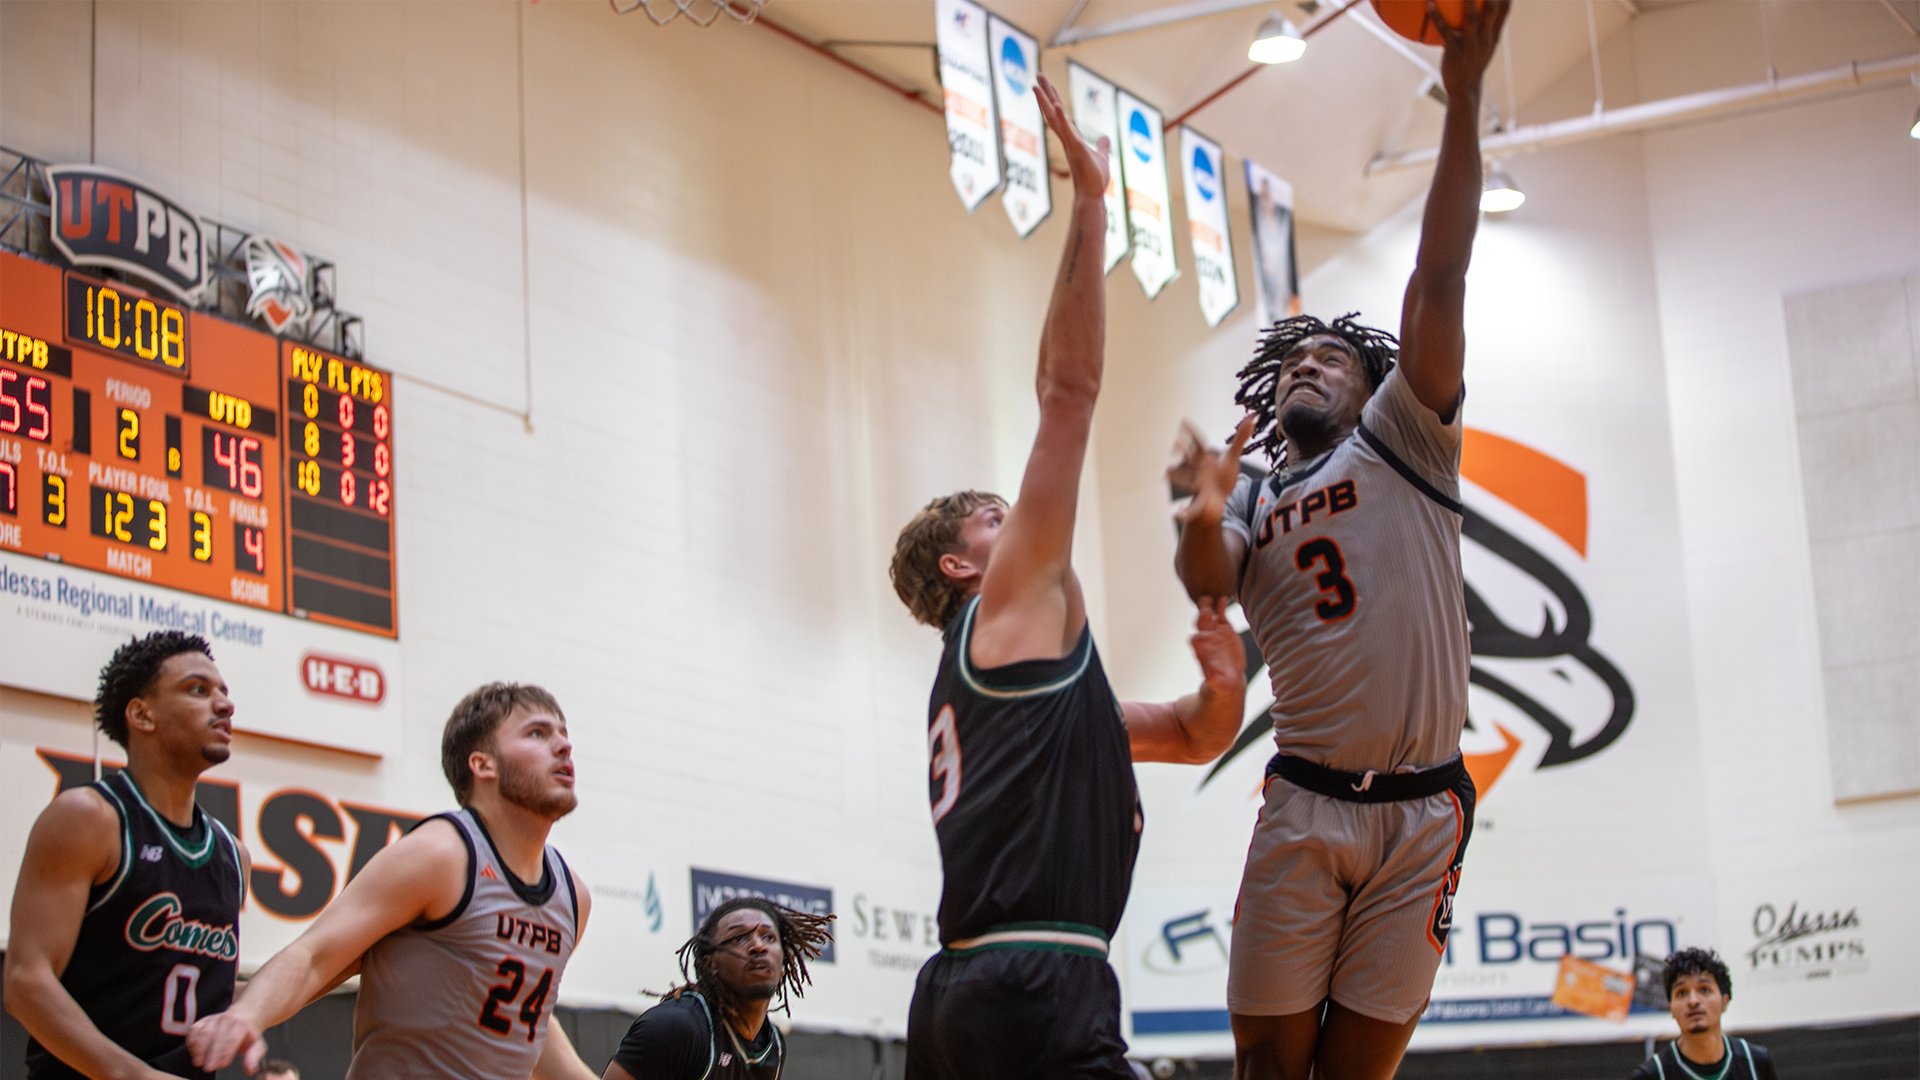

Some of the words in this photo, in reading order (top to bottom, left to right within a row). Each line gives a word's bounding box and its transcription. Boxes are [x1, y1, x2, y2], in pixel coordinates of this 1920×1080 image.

[59, 178, 199, 282] UTPB
[0, 329, 48, 369] TPB
[87, 286, 184, 368] 10:08
[106, 377, 151, 409] PERIOD
[293, 347, 322, 384] PLY
[328, 358, 350, 393] FL
[351, 366, 383, 403] PTS
[0, 368, 49, 440] 55
[209, 390, 251, 428] UTD
[304, 383, 319, 418] 0
[339, 393, 354, 429] 0
[373, 404, 389, 440] 0
[119, 408, 139, 458] 2
[304, 421, 320, 457] 8
[341, 432, 355, 468] 3
[374, 442, 390, 478] 0
[37, 448, 73, 477] T.O.L.
[89, 461, 137, 493] PLAYER
[140, 474, 172, 503] FOUL
[214, 432, 263, 499] 46
[298, 460, 320, 496] 10
[341, 470, 356, 506] 0
[368, 479, 390, 516] 12
[48, 474, 65, 525] 3
[149, 500, 167, 550] 3
[229, 499, 269, 529] FOULS
[1256, 478, 1358, 549] UTPB
[194, 511, 212, 561] 3
[244, 527, 264, 572] 4
[107, 547, 152, 578] MATCH
[1295, 535, 1358, 624] 3
[57, 576, 133, 617] Regional
[139, 594, 206, 635] Medical
[211, 608, 264, 647] Center
[230, 577, 270, 606] SCORE
[125, 891, 238, 961] Comets
[496, 913, 562, 956] UTPB
[1477, 908, 1677, 964] Basin
[1752, 899, 1861, 942] Odessa
[1750, 939, 1865, 968] PUMPS
[161, 963, 201, 1036] 0
[478, 955, 554, 1044] 24
